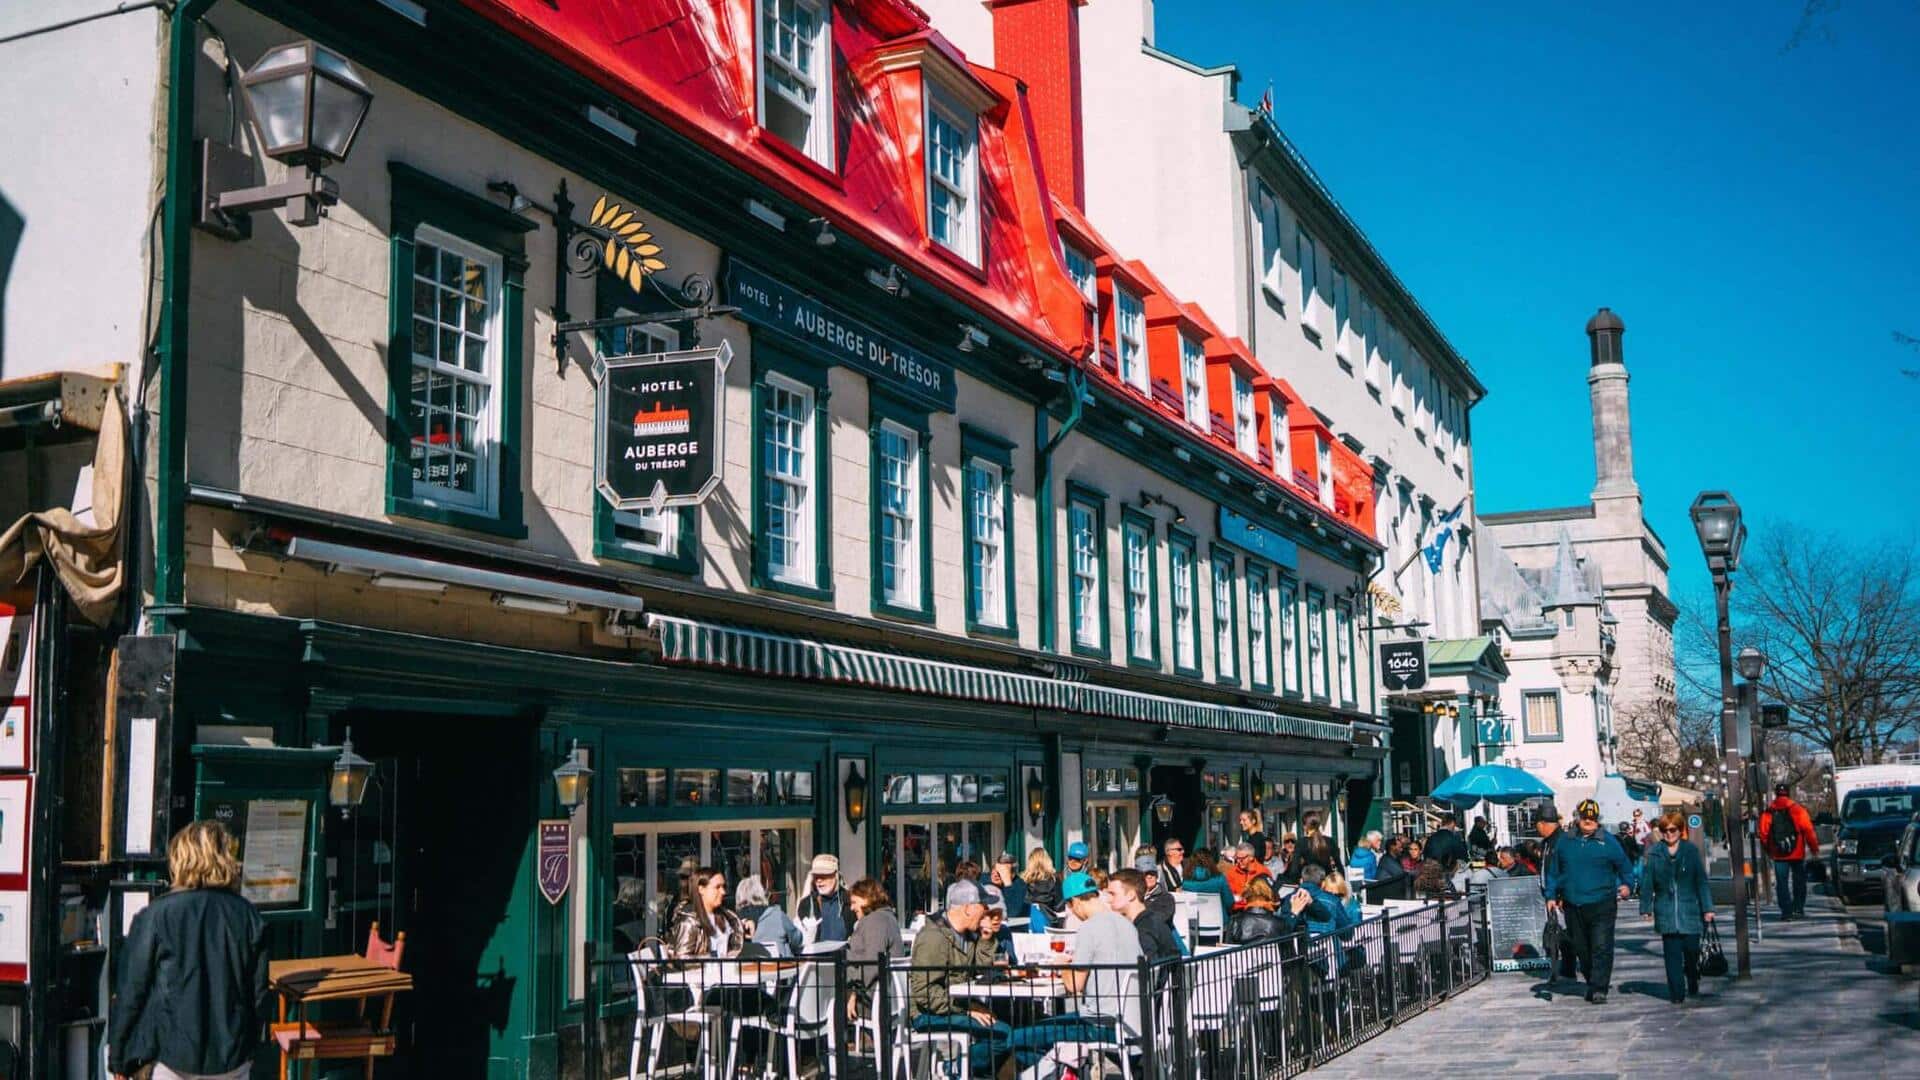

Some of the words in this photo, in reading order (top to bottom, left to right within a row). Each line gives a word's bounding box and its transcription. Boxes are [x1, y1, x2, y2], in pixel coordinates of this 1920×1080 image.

[739, 281, 770, 308] HOTEL
[794, 306, 865, 356] AUBERGE
[868, 341, 887, 366] DU
[891, 352, 941, 392] TRÉSOR
[641, 380, 684, 393] HOTEL
[624, 441, 699, 459] AUBERGE
[635, 461, 648, 470] DU
[650, 459, 687, 470] TRÉSOR
[1387, 657, 1419, 669] 1640
